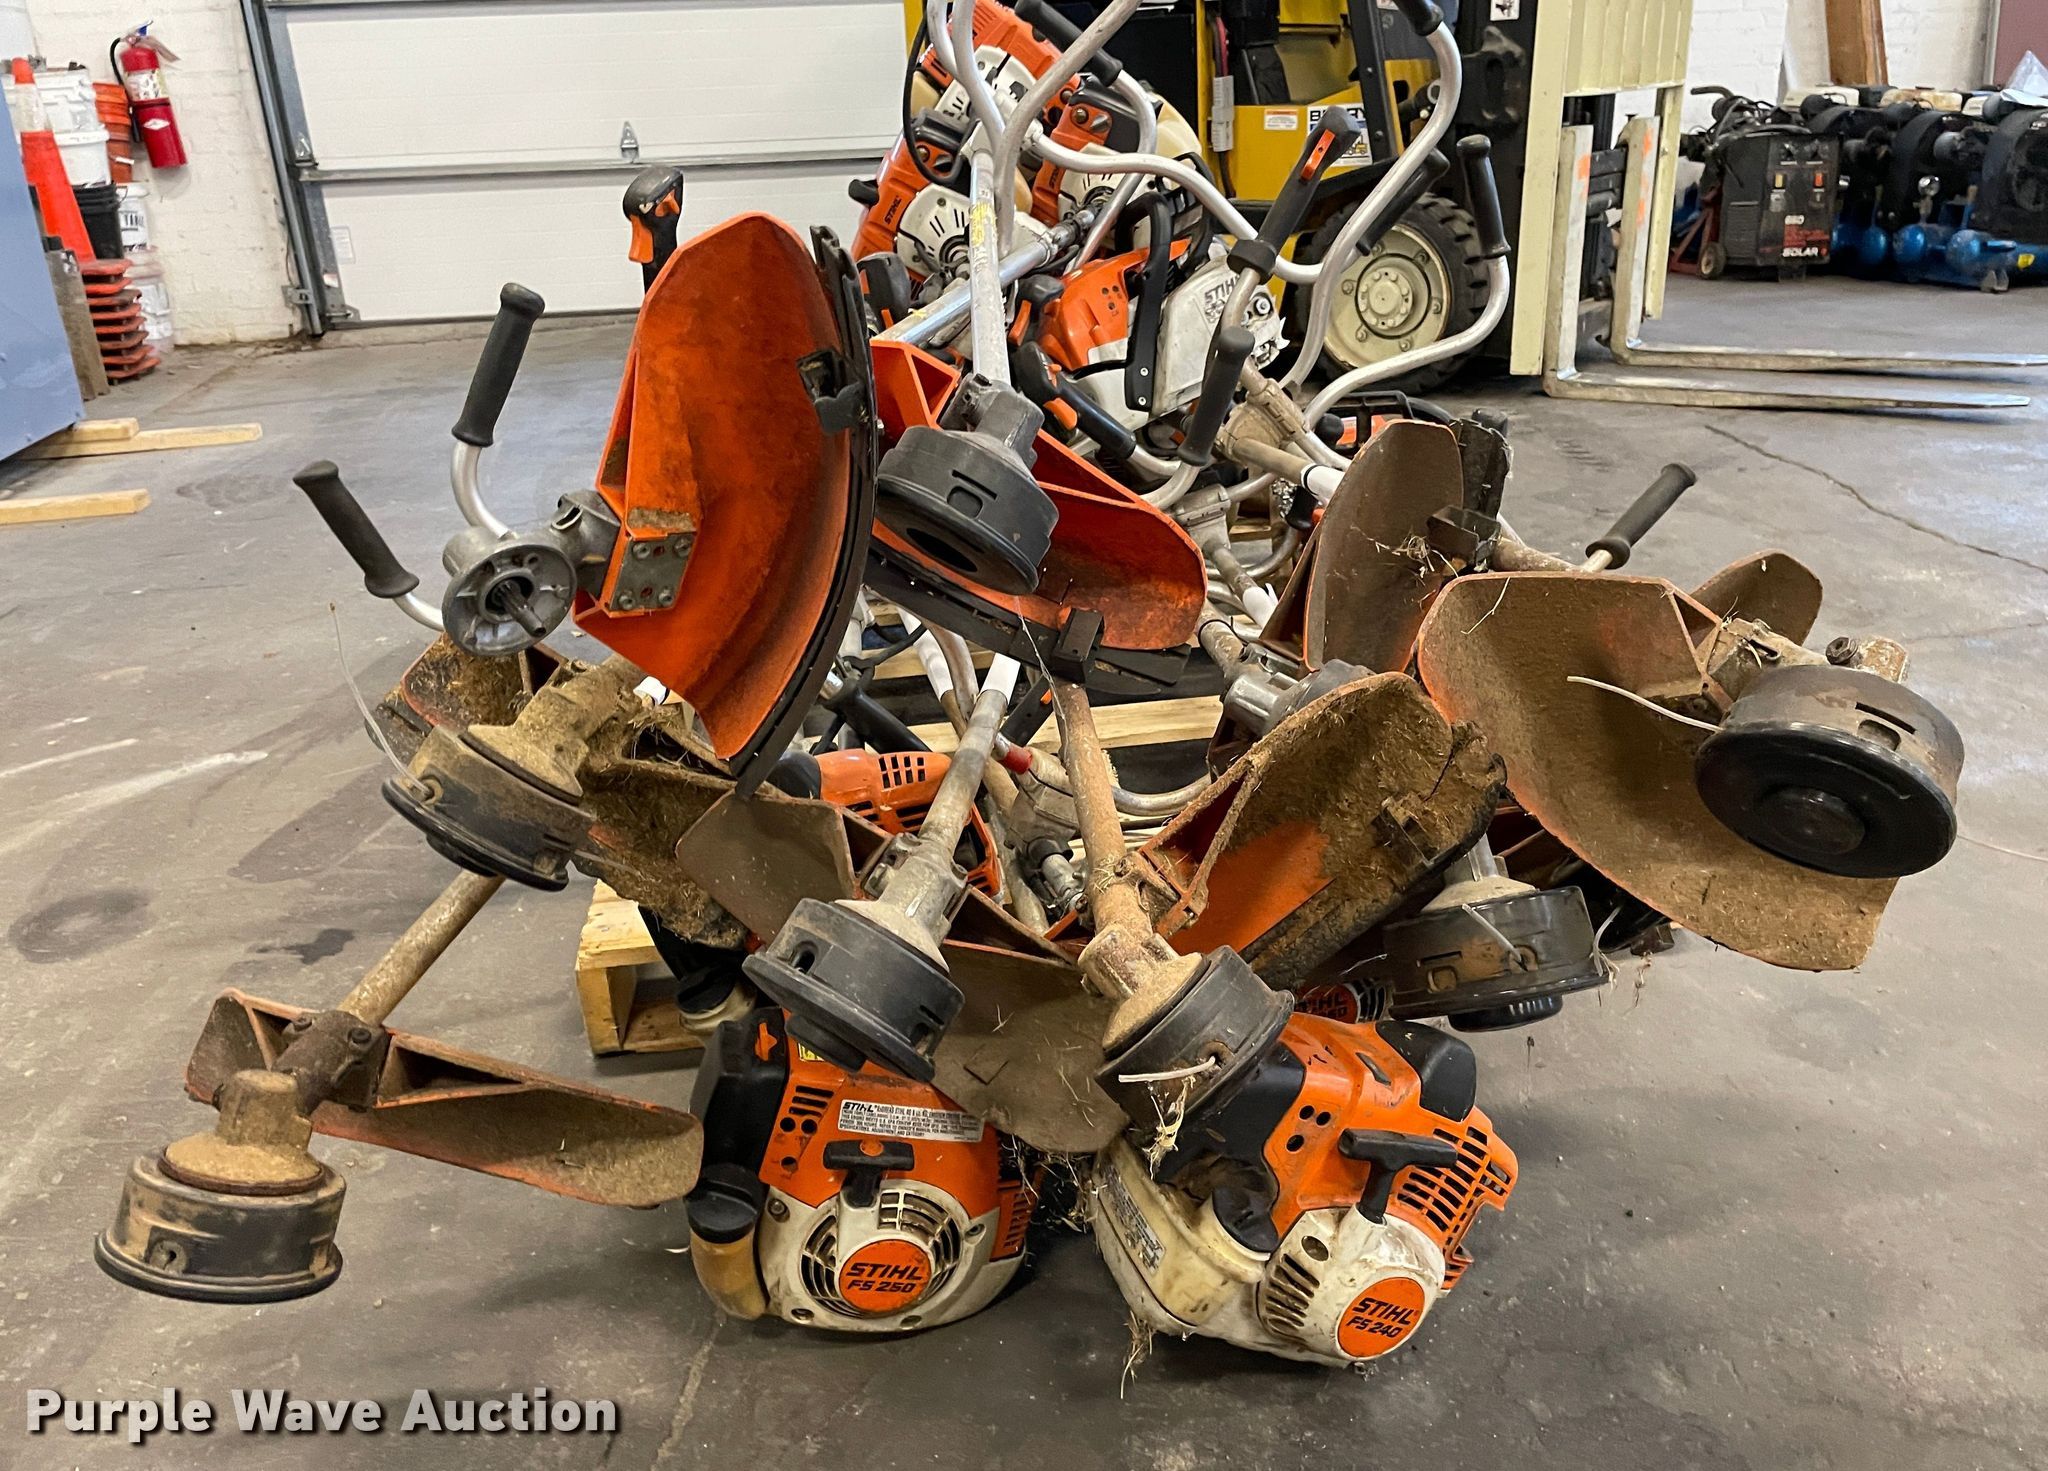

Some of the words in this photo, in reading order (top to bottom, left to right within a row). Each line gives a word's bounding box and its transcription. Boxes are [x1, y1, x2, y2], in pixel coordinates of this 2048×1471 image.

[1783, 248, 1818, 257] SOLAR
[1205, 275, 1240, 303] STIH
[843, 1101, 874, 1113] STIHL
[846, 1262, 923, 1280] STIHL
[848, 1280, 875, 1291] FS
[876, 1281, 916, 1293] 250
[1352, 1297, 1414, 1325] STIHL
[1346, 1315, 1373, 1330] FS
[1368, 1321, 1403, 1338] 240
